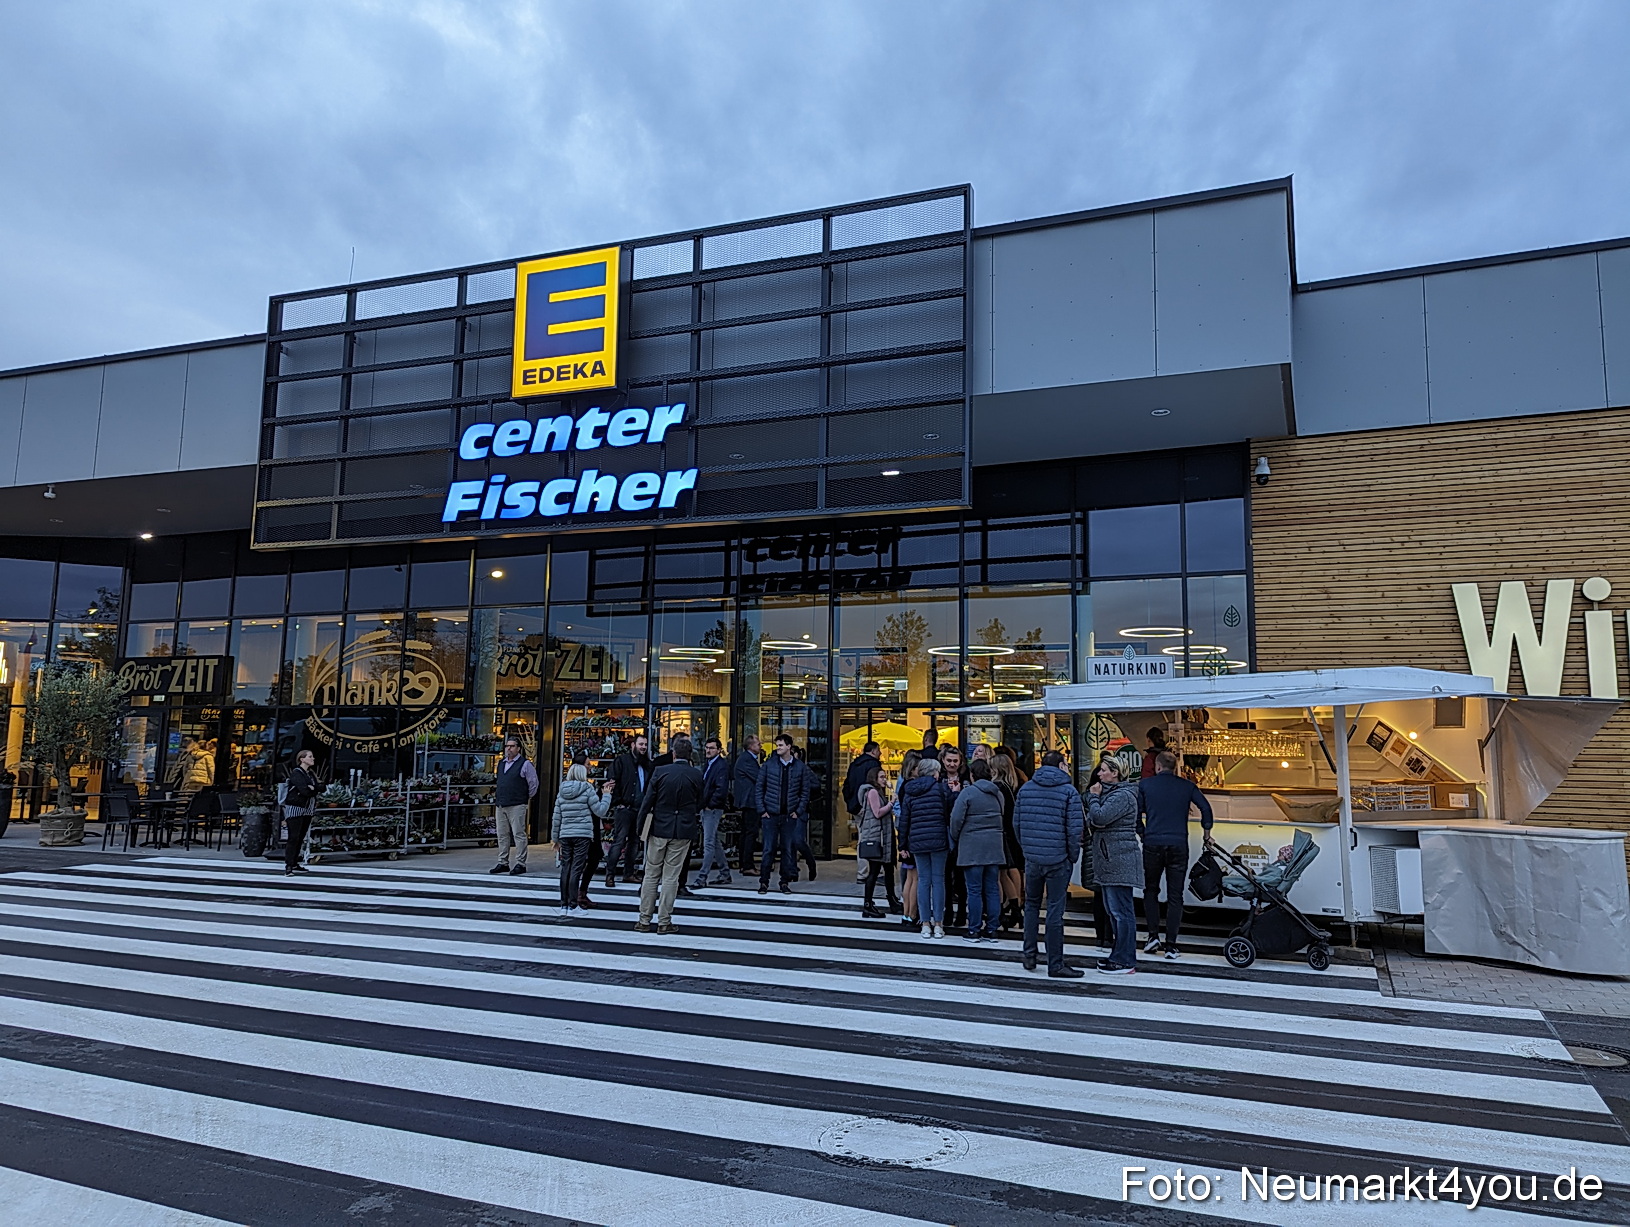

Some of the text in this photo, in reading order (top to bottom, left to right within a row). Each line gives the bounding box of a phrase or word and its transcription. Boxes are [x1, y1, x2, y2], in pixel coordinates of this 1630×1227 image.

[522, 360, 606, 385] EDEKA
[459, 403, 686, 460] center
[441, 468, 698, 523] Fischer
[1452, 577, 1630, 699] Wi
[119, 658, 219, 697] Brot ZEIT
[557, 642, 635, 681] ZEIT
[1094, 662, 1167, 676] NATURKIND
[354, 741, 380, 753] Café
